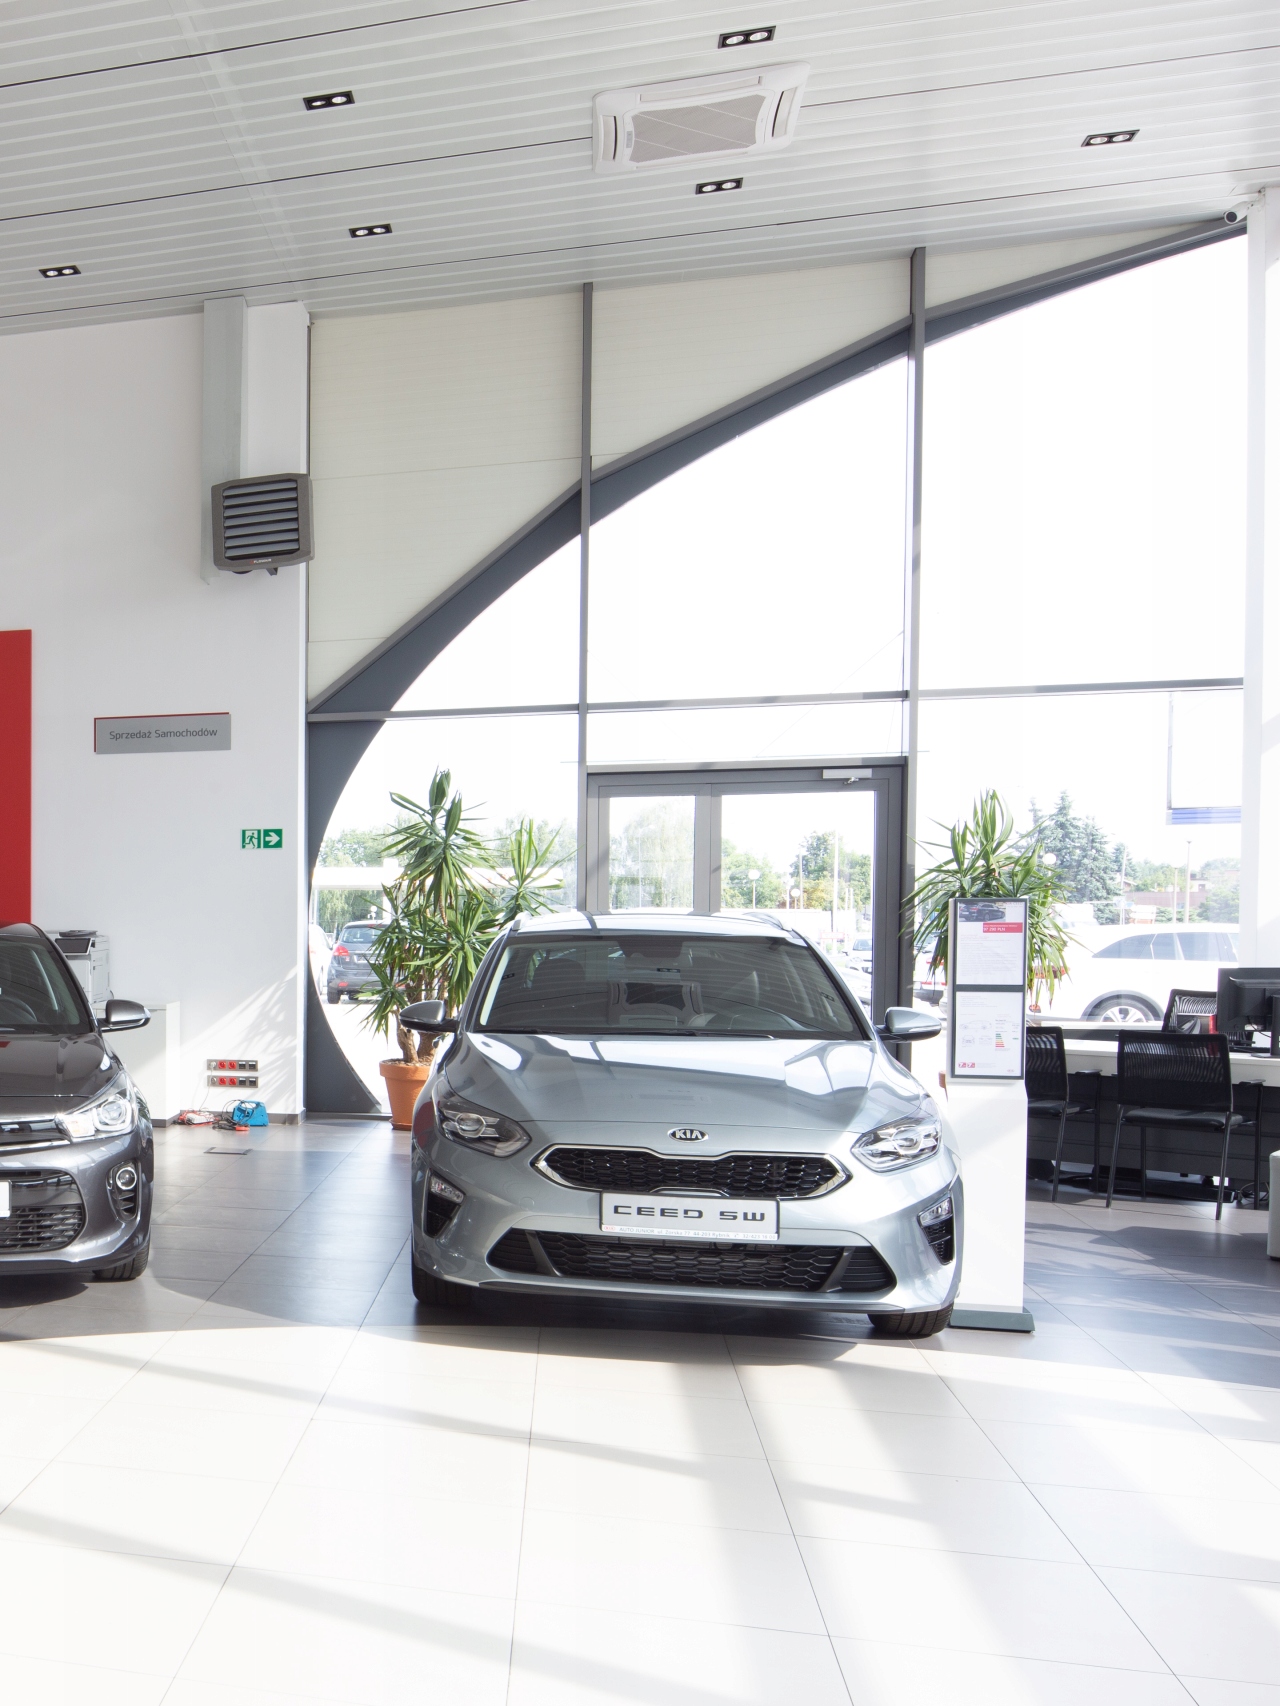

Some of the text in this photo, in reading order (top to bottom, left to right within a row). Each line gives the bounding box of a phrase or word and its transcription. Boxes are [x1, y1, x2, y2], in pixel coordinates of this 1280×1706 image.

[109, 728, 218, 741] Sprzedaż Samochodów
[675, 1129, 703, 1139] KIA
[613, 1205, 765, 1222] CEED SW
